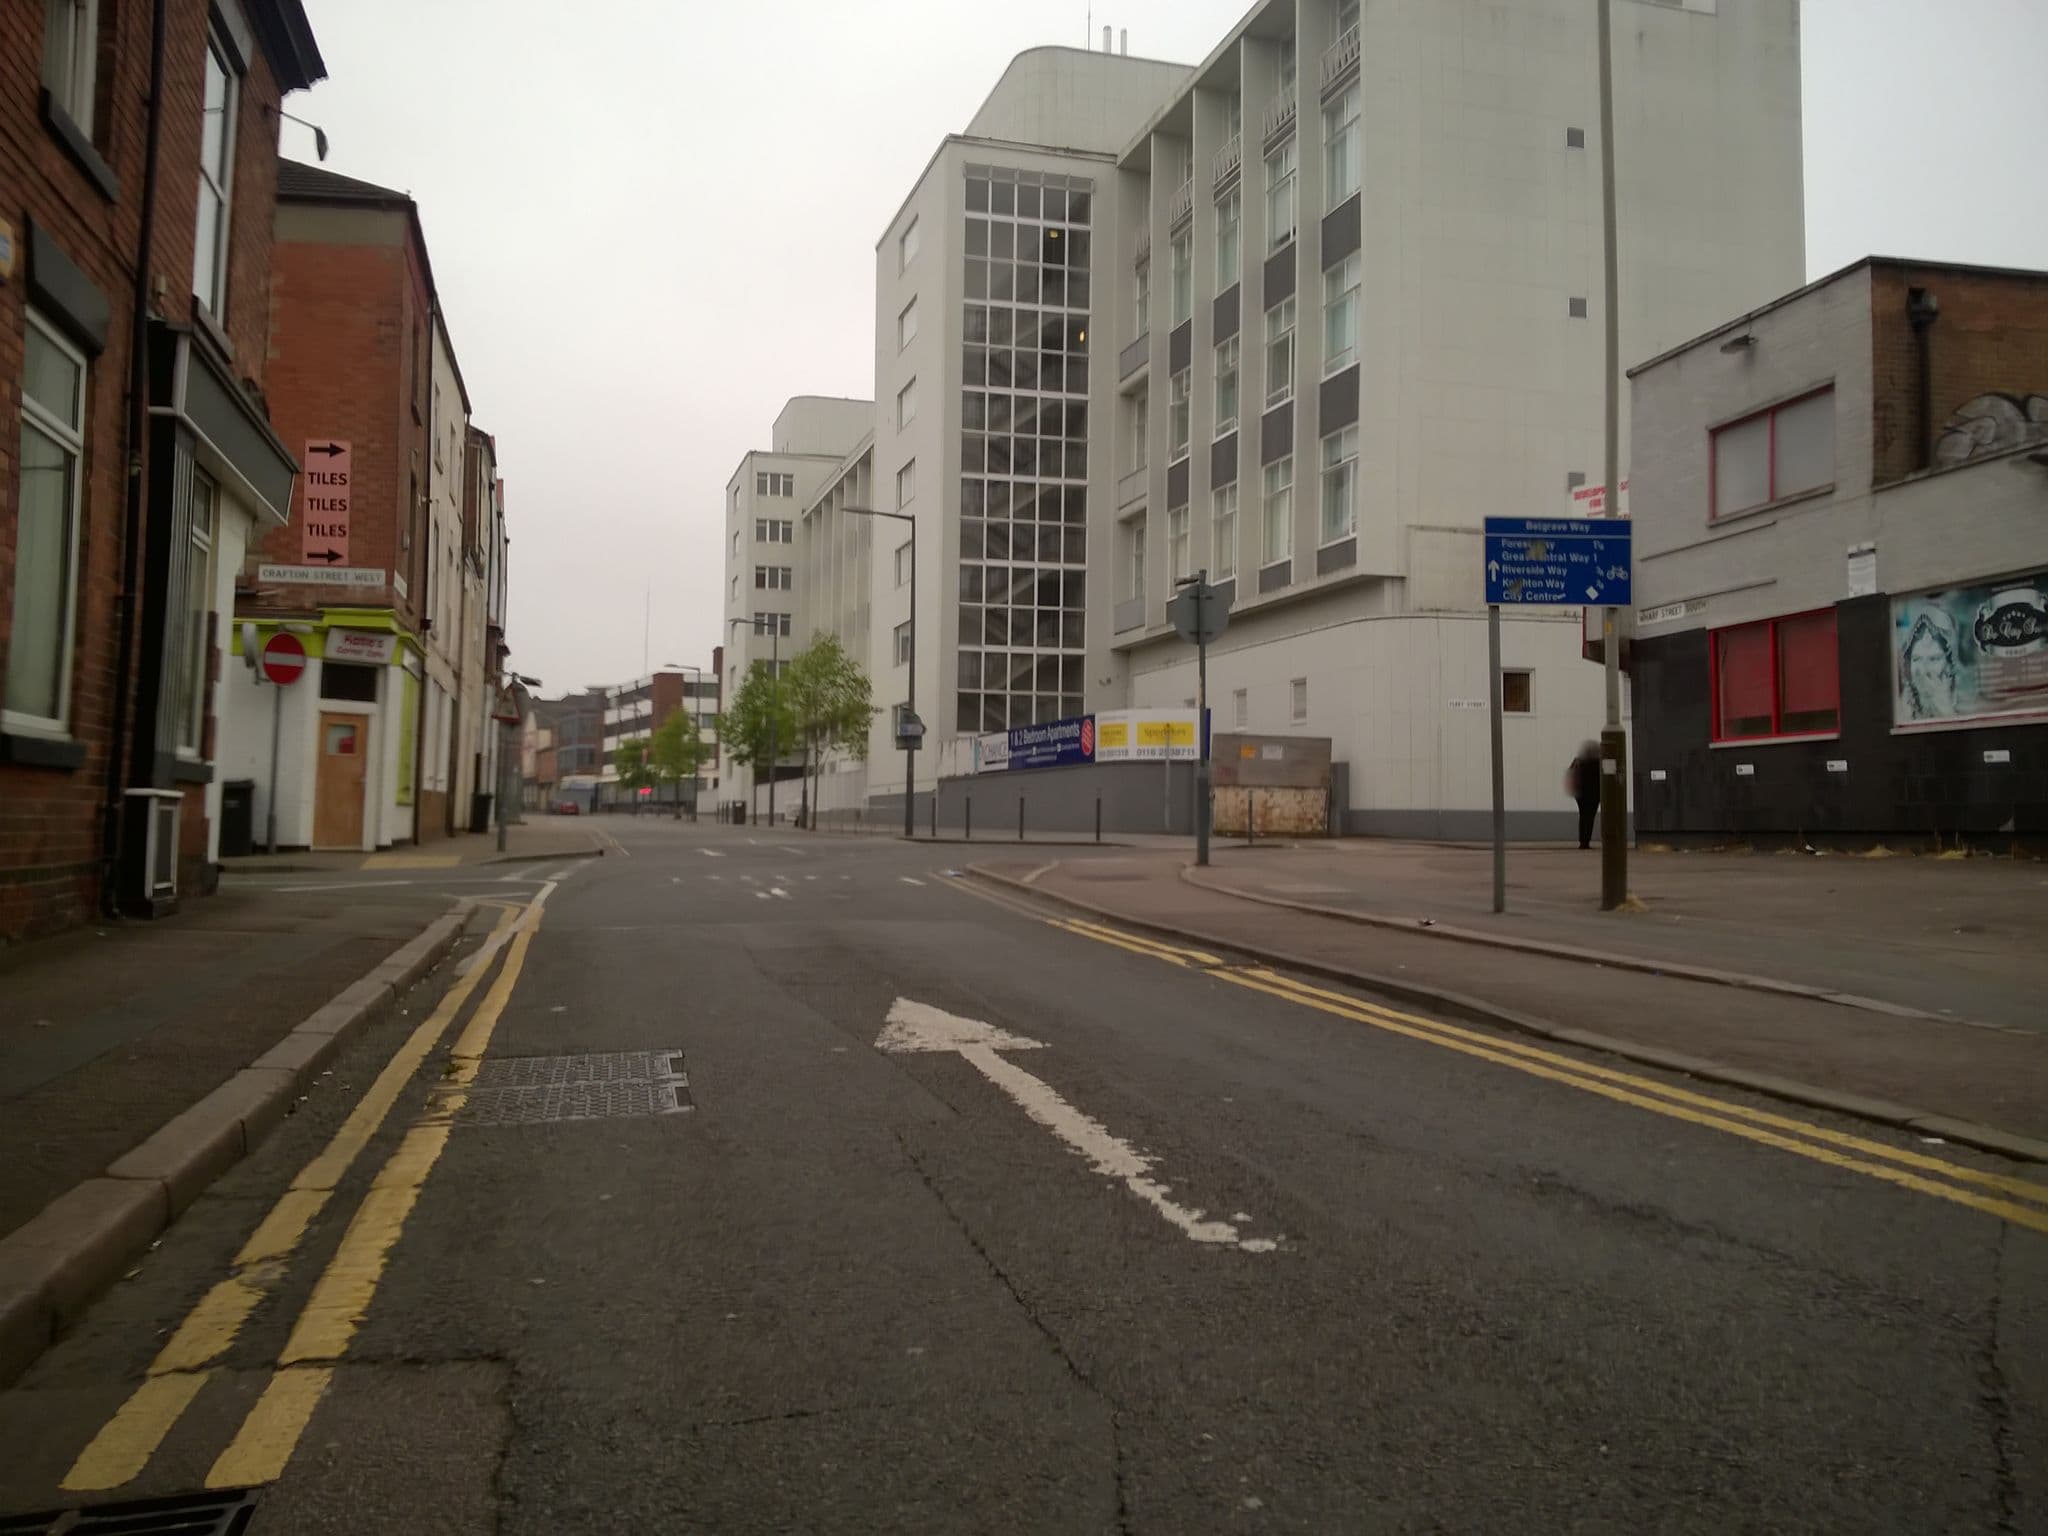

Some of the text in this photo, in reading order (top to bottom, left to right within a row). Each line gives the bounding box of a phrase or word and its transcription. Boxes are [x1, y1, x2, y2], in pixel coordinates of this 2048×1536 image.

[308, 472, 348, 485] TILES
[307, 498, 348, 511] TILES
[307, 523, 347, 537] TILES
[1526, 520, 1591, 534] Belgrave Way
[1502, 538, 1530, 549] Fores
[1502, 551, 1529, 562] Grea
[1569, 553, 1590, 565] Way
[262, 568, 381, 583] CRAFTON STREET WEST
[1502, 565, 1568, 578] Riverside Way
[1545, 578, 1566, 591] Way
[1526, 591, 1559, 602] Centre
[1640, 610, 1659, 622] WHARF
[1661, 605, 1682, 618] STREET
[1023, 728, 1047, 745] Bedroom
[1047, 721, 1080, 744] Apartments
[1136, 747, 1156, 757] 0116
